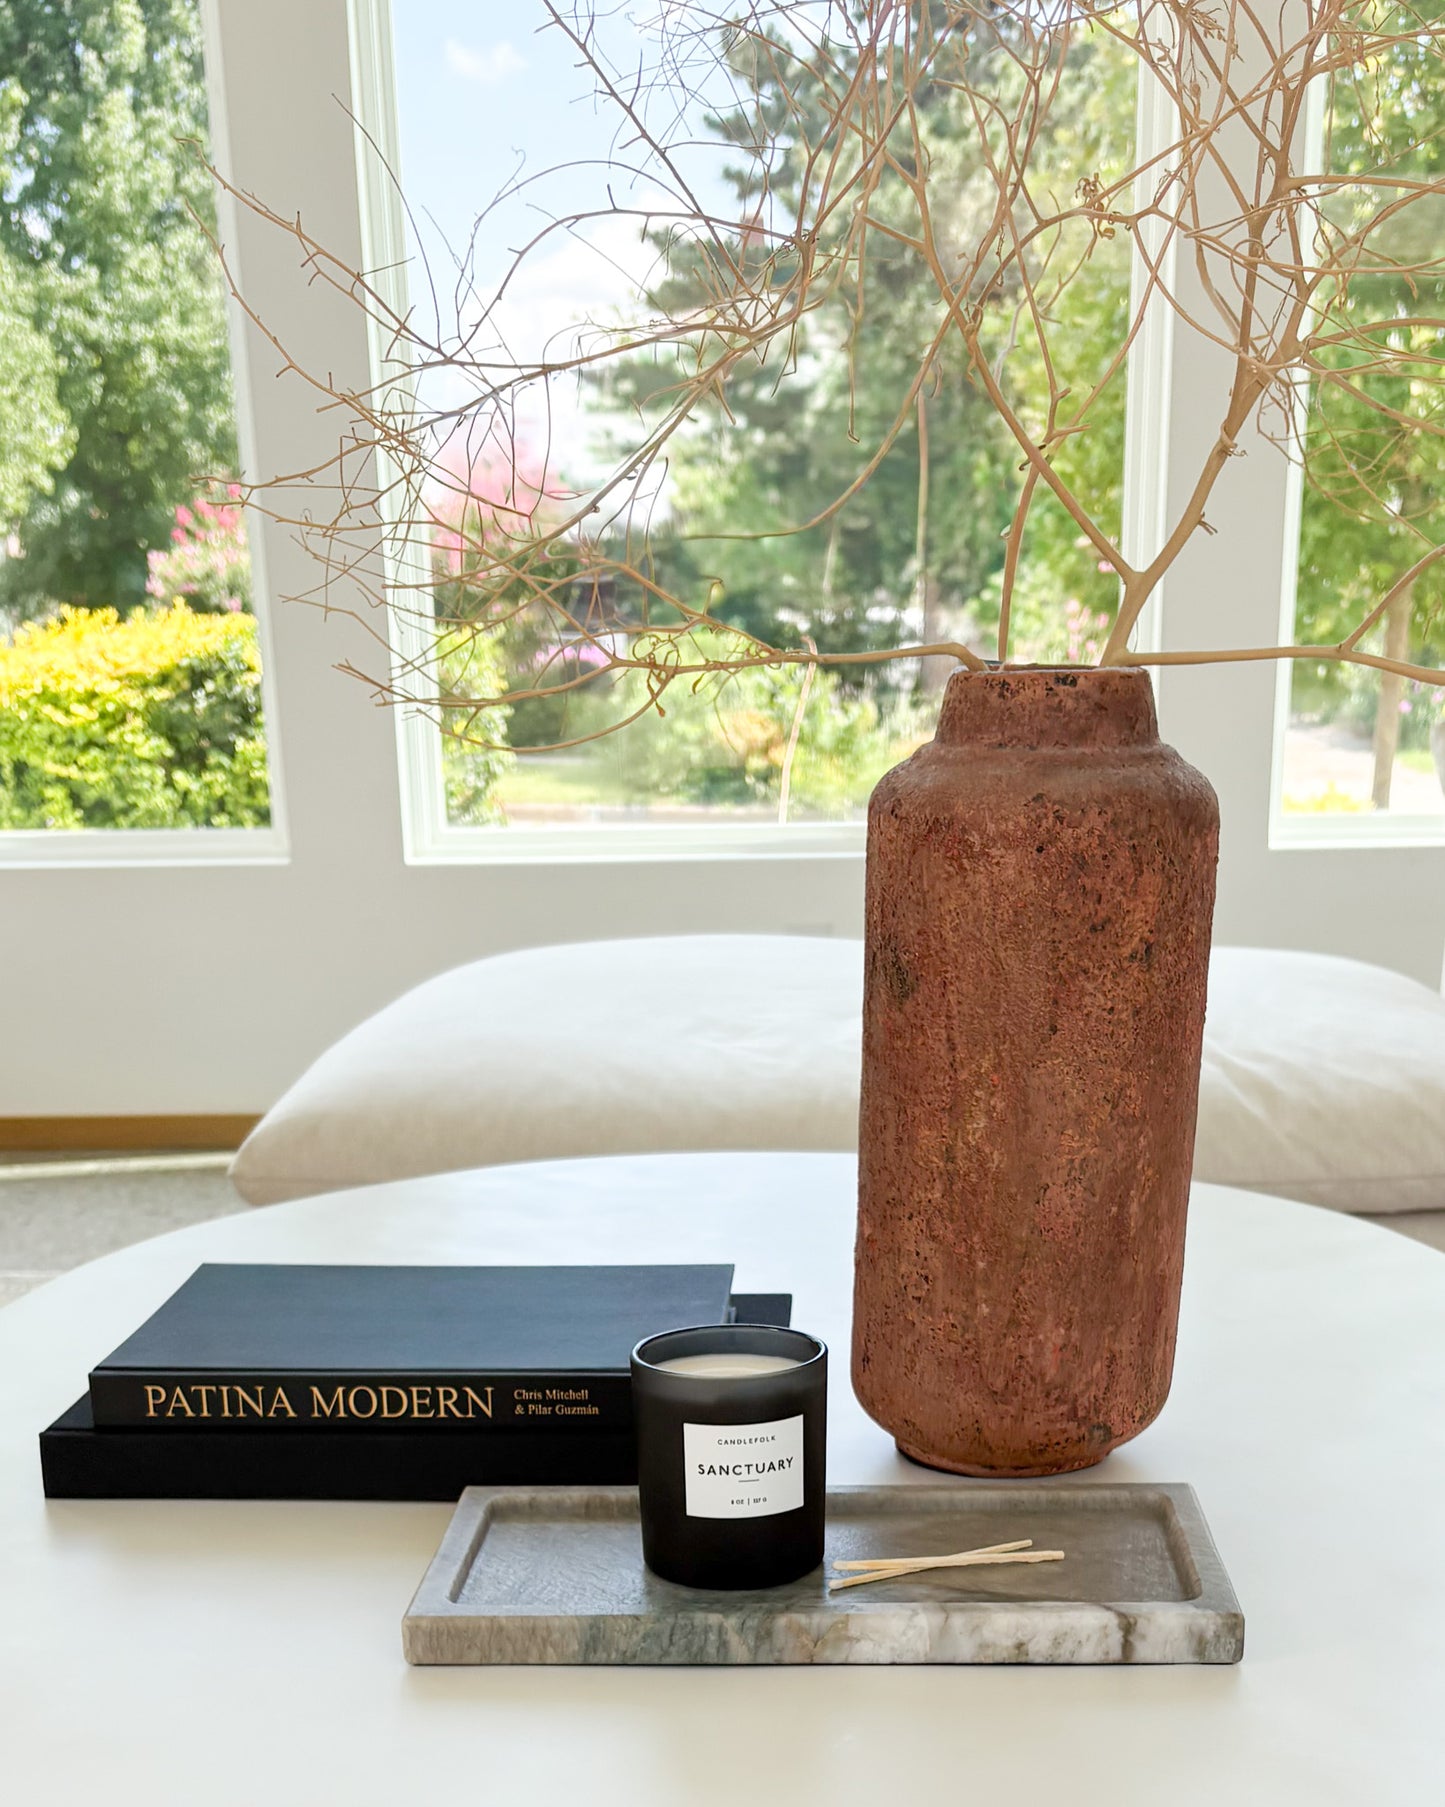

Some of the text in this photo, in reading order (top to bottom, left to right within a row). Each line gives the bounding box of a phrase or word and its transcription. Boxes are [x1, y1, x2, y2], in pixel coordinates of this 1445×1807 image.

[513, 1389, 589, 1400] Chris Mitchell
[143, 1385, 495, 1419] PATINA MODERN
[514, 1404, 599, 1415] & Pilar Guzmán
[717, 1435, 776, 1446] CANDLEFOLK
[697, 1456, 794, 1476] SANCTUARY
